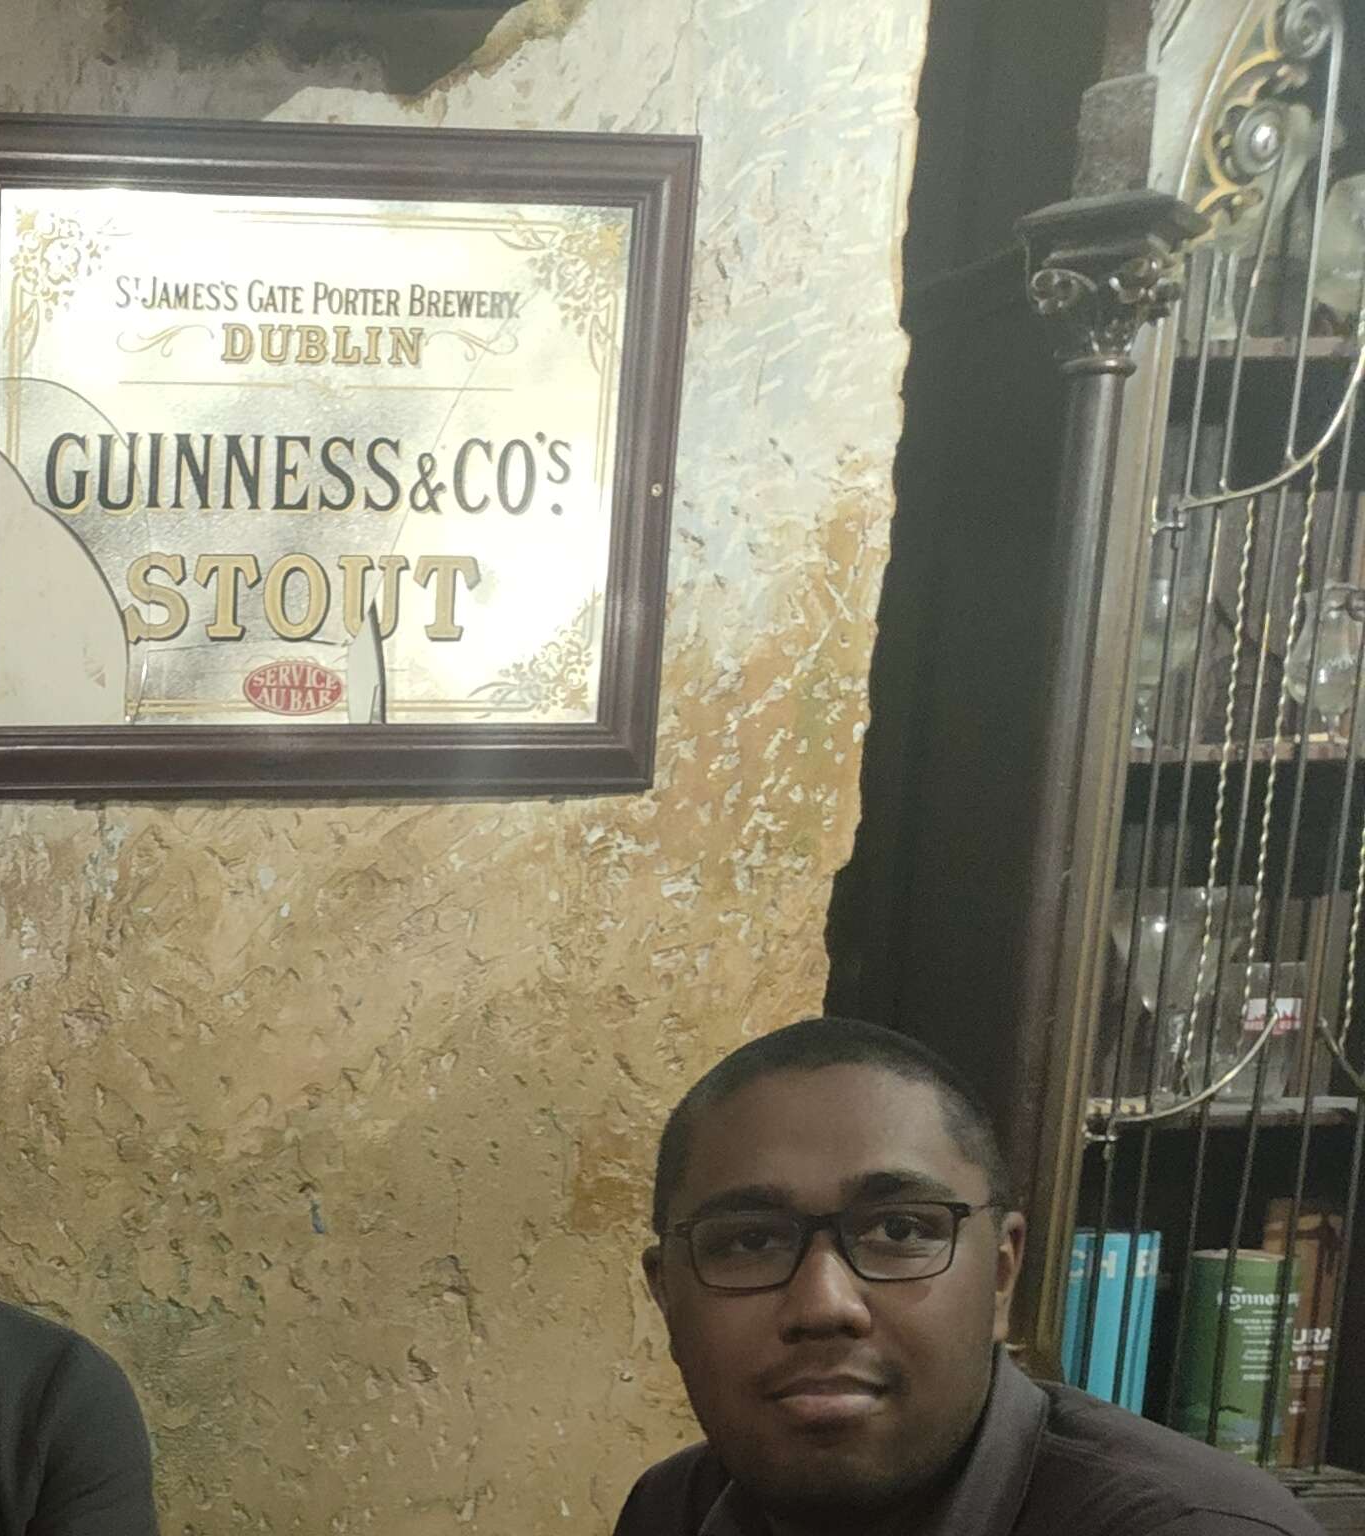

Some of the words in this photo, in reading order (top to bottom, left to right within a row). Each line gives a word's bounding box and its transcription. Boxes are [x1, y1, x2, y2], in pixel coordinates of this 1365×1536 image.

[141, 276, 238, 311] JAMES'S
[247, 280, 304, 314] GATE
[312, 282, 400, 316] PORTER
[221, 323, 425, 366] DUBLIN
[123, 552, 482, 644] STOUT
[251, 663, 339, 690] SERVICE
[257, 687, 287, 709] AU
[290, 688, 332, 711] BAR
